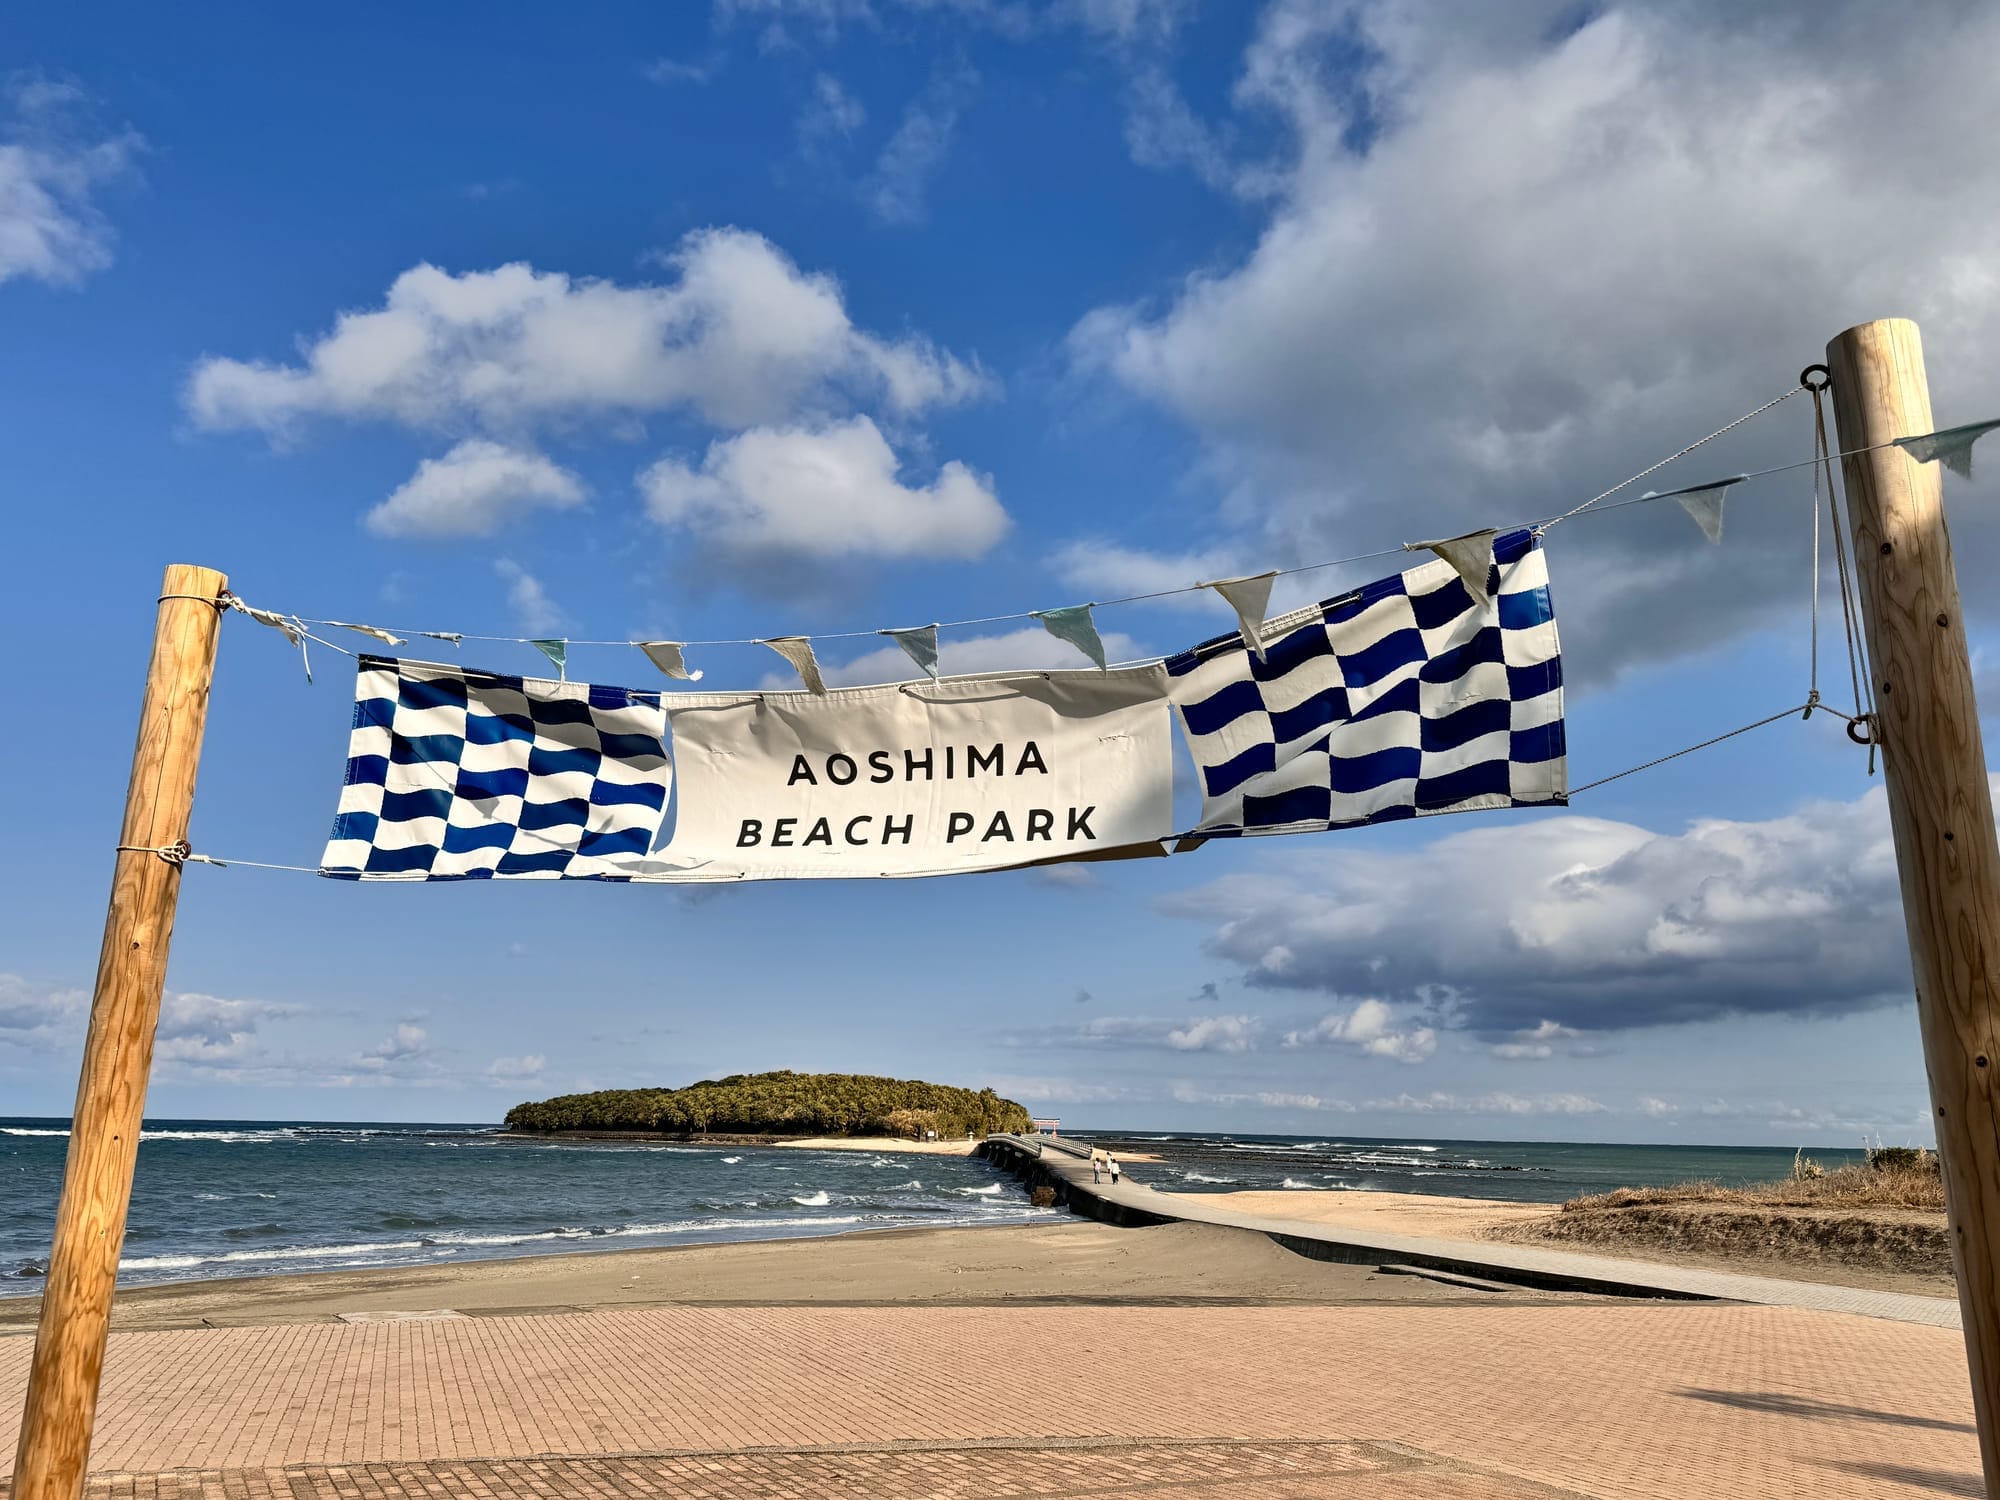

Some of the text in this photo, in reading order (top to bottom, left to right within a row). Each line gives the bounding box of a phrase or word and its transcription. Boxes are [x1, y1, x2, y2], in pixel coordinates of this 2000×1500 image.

[787, 741, 1049, 786] AOSHIMA
[736, 806, 1097, 848] BEACH PARK
